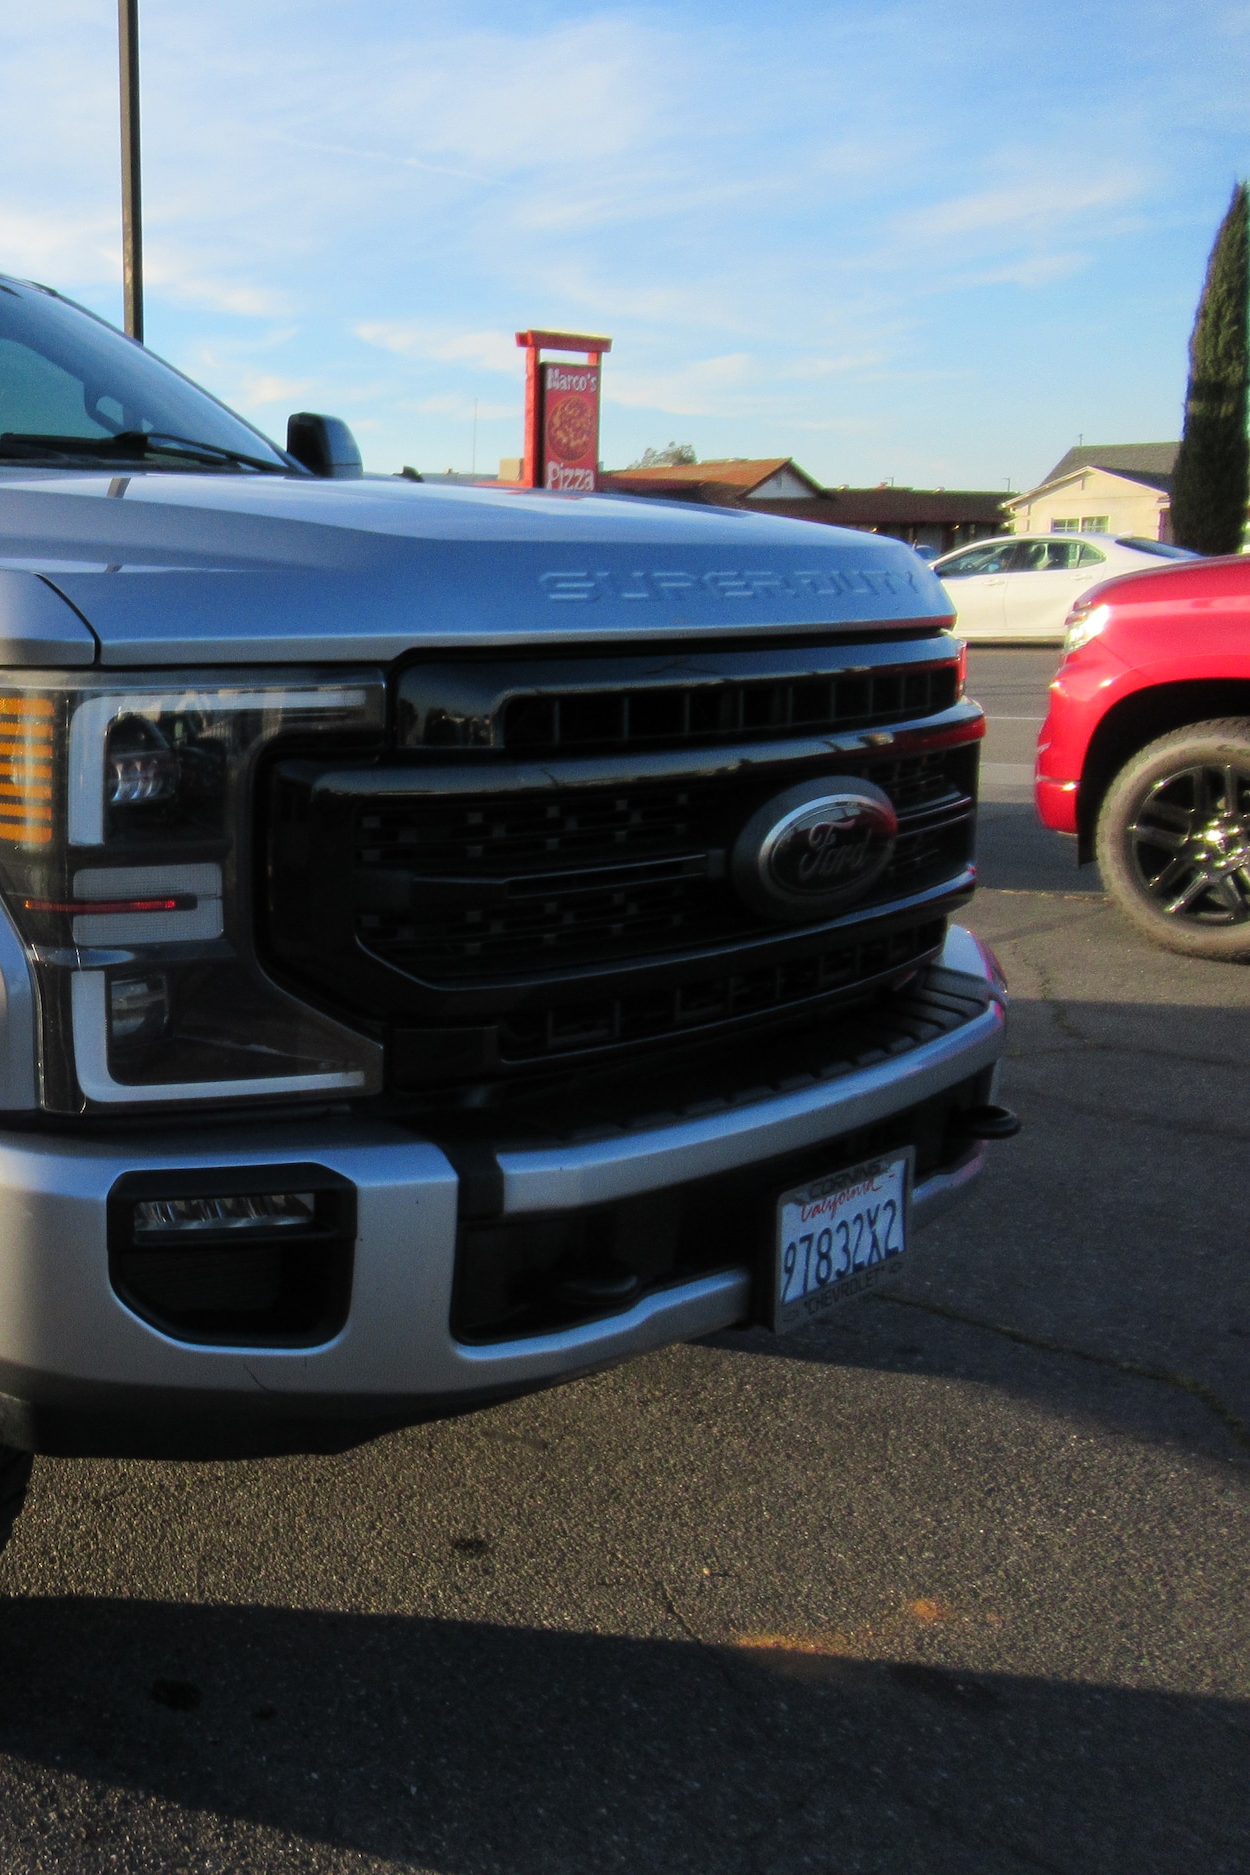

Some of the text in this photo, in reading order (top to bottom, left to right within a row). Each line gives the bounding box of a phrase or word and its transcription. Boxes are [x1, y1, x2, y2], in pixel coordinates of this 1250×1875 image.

[546, 368, 598, 392] Marco's
[546, 461, 596, 491] Pizza
[539, 570, 797, 600] SUPER
[798, 818, 873, 881] Ford
[801, 1179, 883, 1222] California
[782, 1199, 899, 1304] 97832X2
